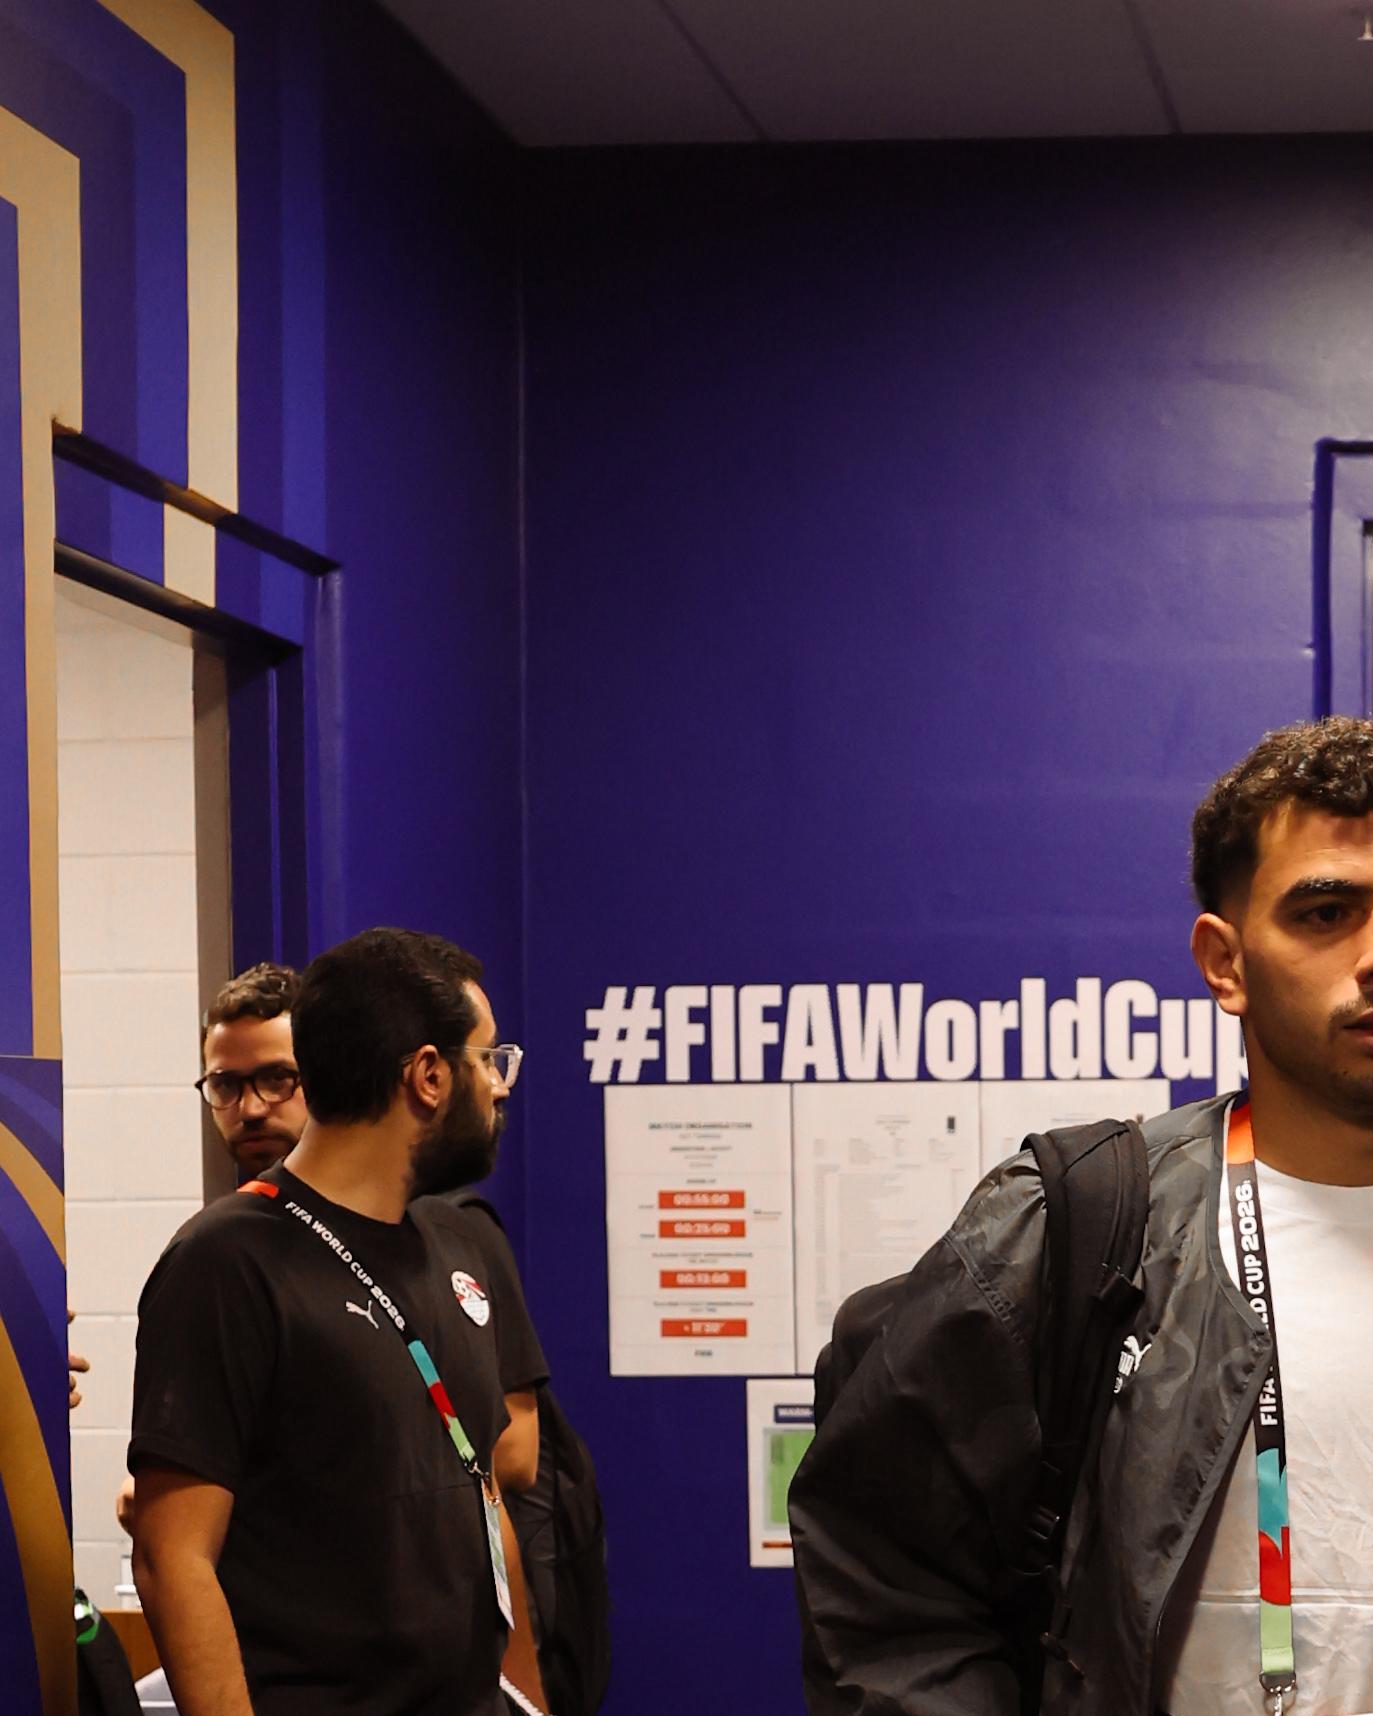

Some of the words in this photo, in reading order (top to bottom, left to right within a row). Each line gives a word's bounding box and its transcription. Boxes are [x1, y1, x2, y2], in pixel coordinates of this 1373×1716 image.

[1235, 1182, 1260, 1252] 2026
[285, 1201, 313, 1225] FIFA
[312, 1220, 353, 1263] WORLD
[350, 1261, 374, 1287] CUP
[370, 1285, 406, 1331] 2026
[1244, 1254, 1265, 1295] CUP
[1259, 1377, 1278, 1426] FIFA
